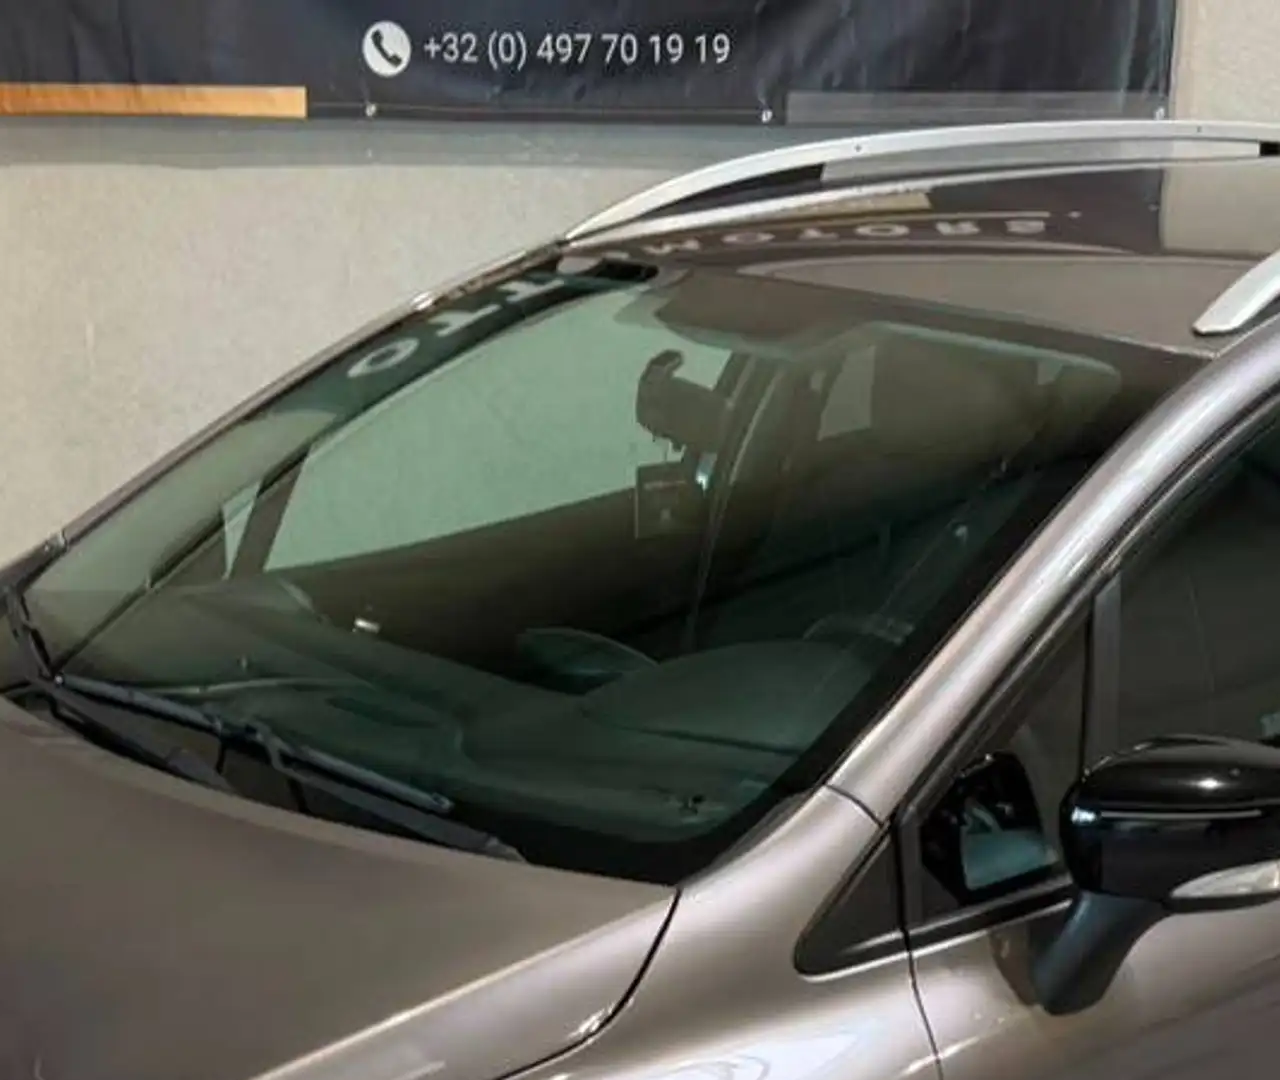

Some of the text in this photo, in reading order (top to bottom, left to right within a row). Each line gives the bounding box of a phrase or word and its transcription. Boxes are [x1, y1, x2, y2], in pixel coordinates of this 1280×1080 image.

[423, 29, 731, 71] +32 (0) 497 70 19 19
